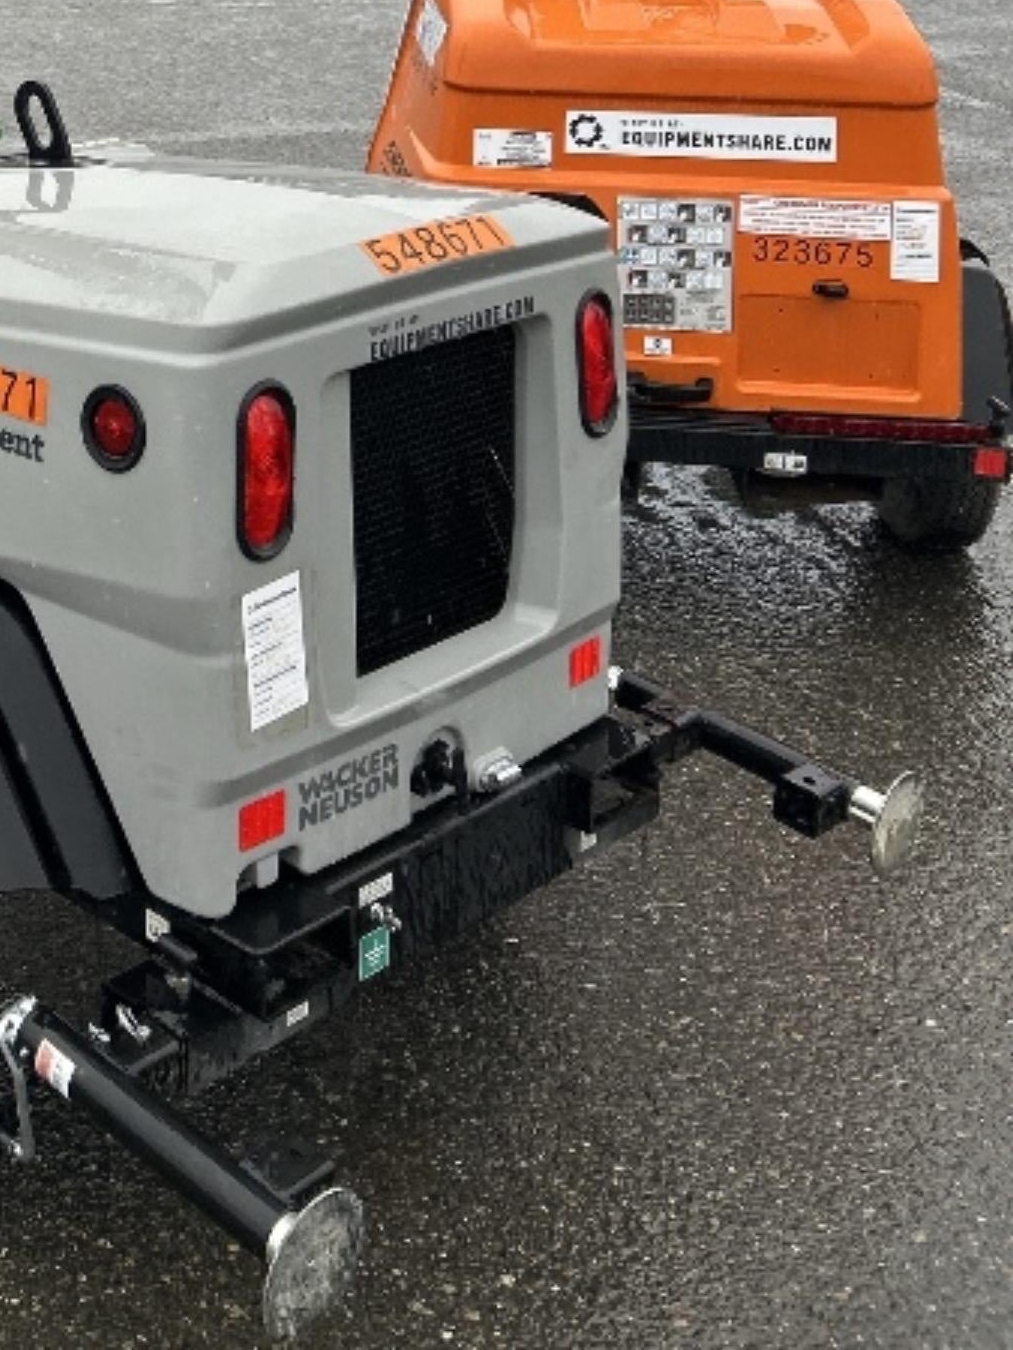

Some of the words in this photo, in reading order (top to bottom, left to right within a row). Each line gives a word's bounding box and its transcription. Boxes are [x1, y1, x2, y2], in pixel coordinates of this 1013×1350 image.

[622, 130, 832, 153] EQUIPMENTSHARE.COM
[364, 216, 506, 274] 548671
[753, 236, 874, 268] 323675
[297, 743, 399, 804] WACKER
[297, 761, 399, 832] NEUSON
